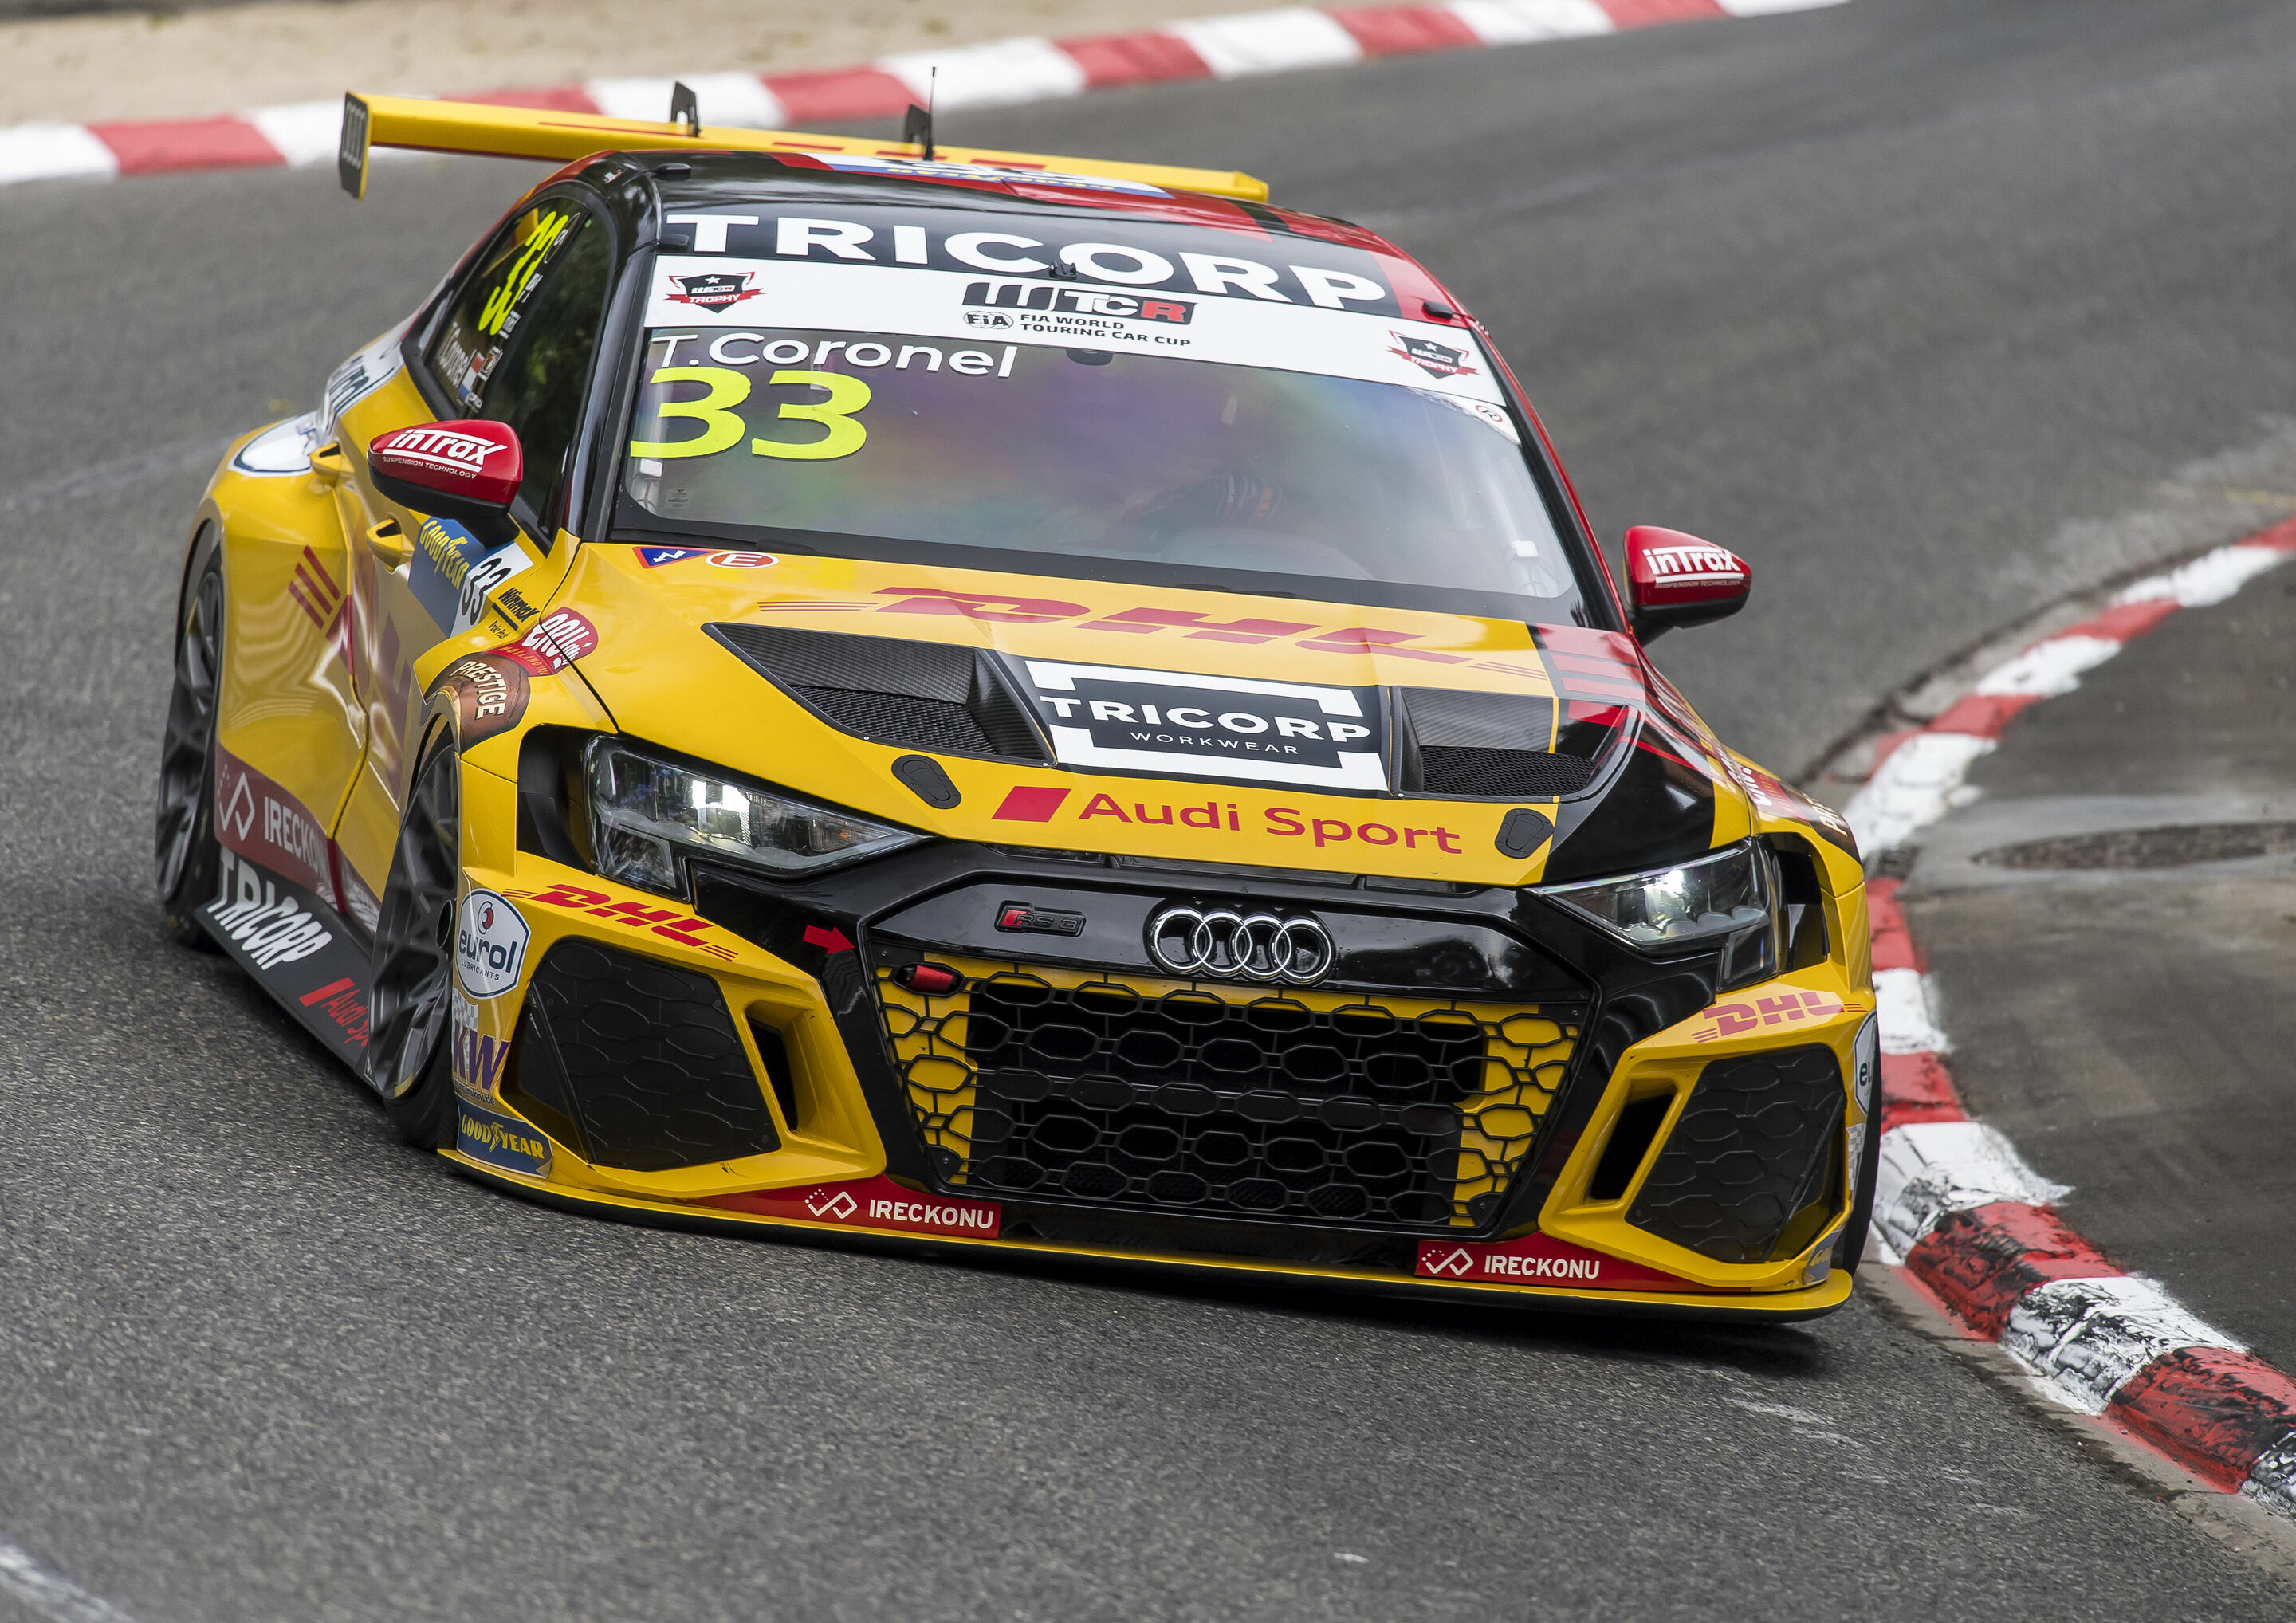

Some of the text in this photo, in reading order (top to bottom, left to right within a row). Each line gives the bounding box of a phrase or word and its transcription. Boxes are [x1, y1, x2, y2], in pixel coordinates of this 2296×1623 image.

[666, 214, 1386, 309] TRICORP
[690, 293, 740, 304] TROPHY
[1020, 313, 1124, 329] FIA WORLD
[651, 332, 1018, 379] T.Coronel
[1020, 323, 1191, 346] TOURING CAR CUP
[630, 366, 872, 461] 33
[383, 456, 477, 479] SUSPENSION TECHNOLOGY
[419, 520, 470, 590] GOODYEAR
[461, 557, 512, 626] 33
[871, 587, 1473, 665] DHL
[497, 646, 543, 666] HOLLAND
[450, 661, 507, 721] PRESTIGE
[1039, 695, 1370, 743] TRICORP
[1129, 731, 1299, 755] WORKWEAR
[1078, 792, 1463, 855] Audi Sport
[207, 844, 333, 971] TRICORP
[529, 884, 714, 947] DHL
[458, 929, 518, 974] eurol
[461, 958, 500, 981] LUBRICANTS
[320, 988, 369, 1028] Audi
[1702, 992, 1845, 1037] DHL
[453, 1020, 512, 1091] KW
[461, 1114, 545, 1160] GOODYEAR
[867, 1198, 994, 1230] IRECKONU
[1484, 1256, 1601, 1279] IRECKONU
